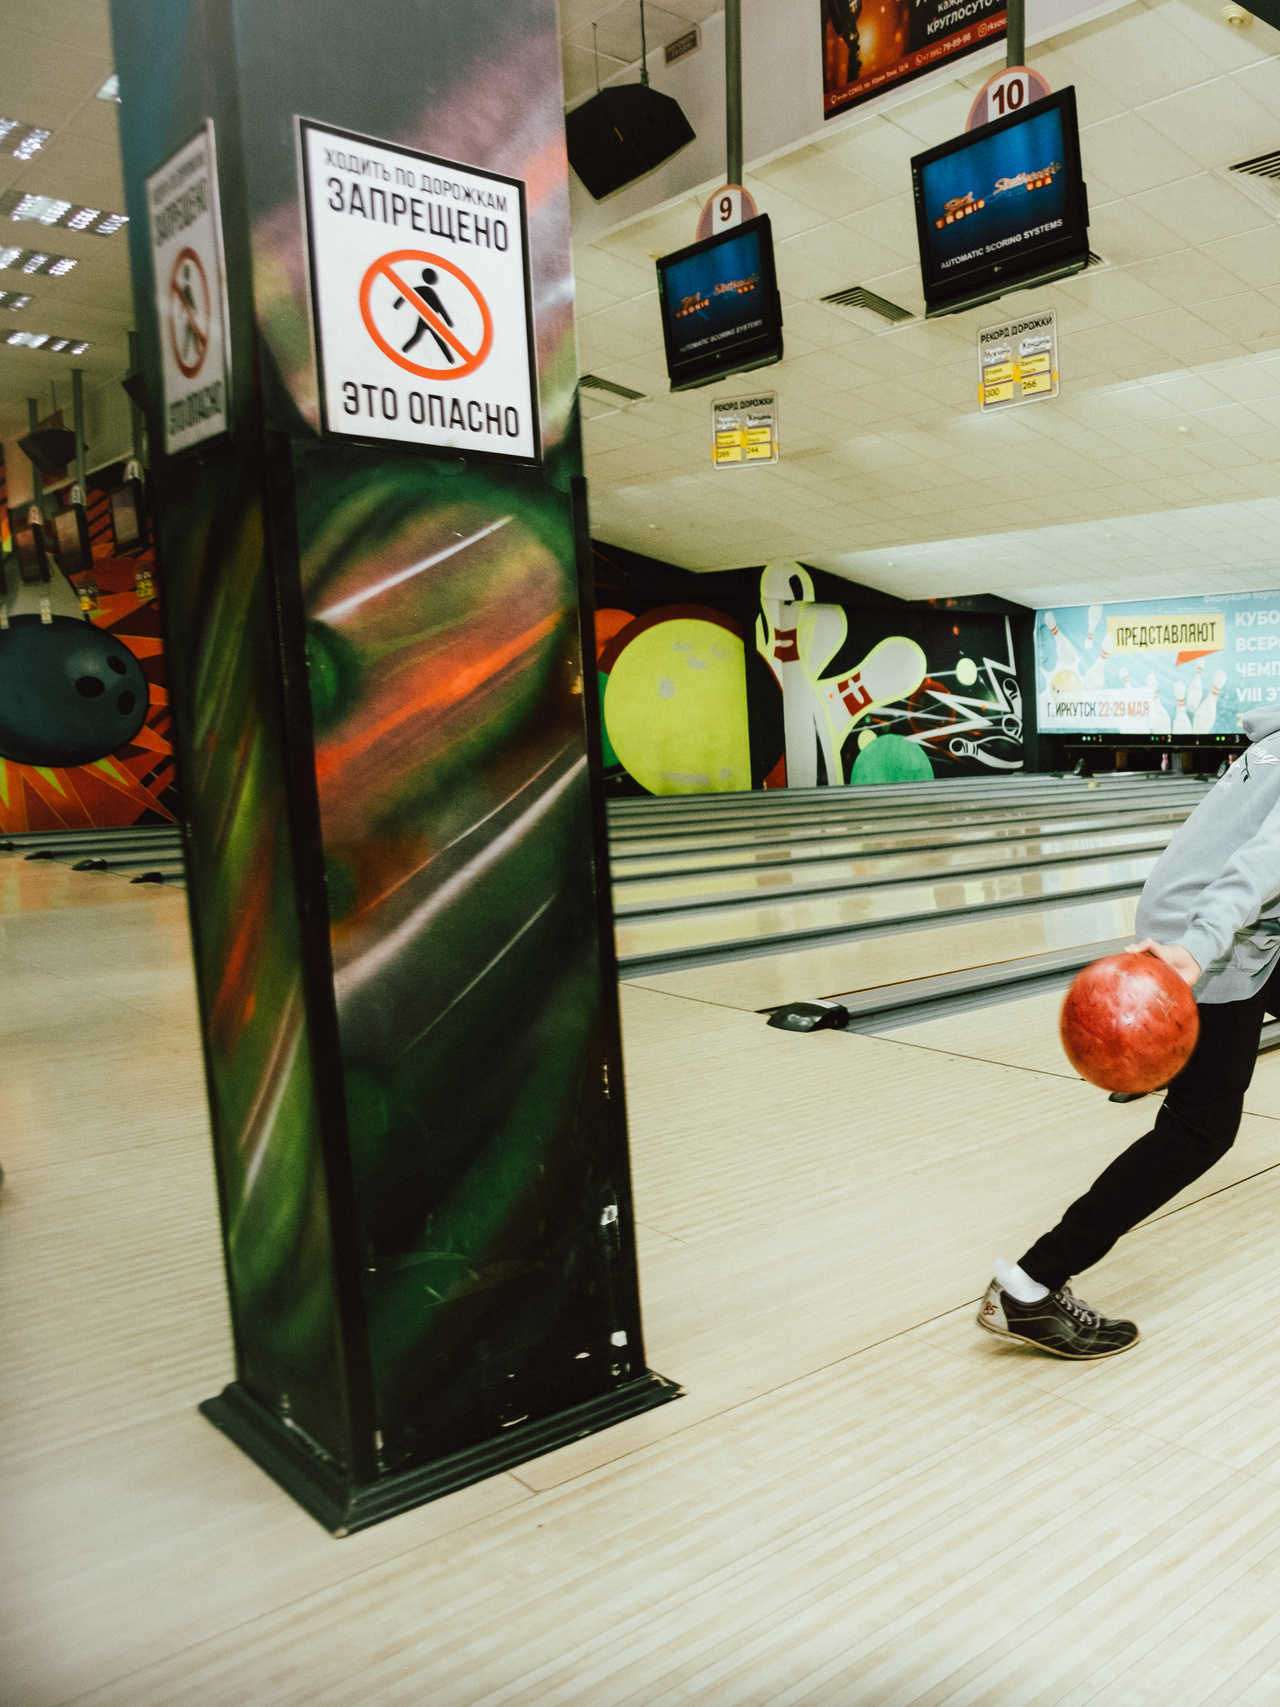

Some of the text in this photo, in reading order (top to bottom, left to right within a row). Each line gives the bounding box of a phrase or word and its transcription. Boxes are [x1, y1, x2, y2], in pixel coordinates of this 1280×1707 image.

[927, 0, 1000, 34] КРУГЛОСУТО
[992, 78, 1024, 115] 10
[324, 147, 508, 213] ХОДИТЬ ПО ДОРОЖКАМ
[327, 177, 509, 252] ЗАПРЕЩЕНО
[719, 197, 732, 222] 9
[941, 219, 1063, 269] AUTOMATIC SCORING SYSTEMS
[981, 316, 1052, 343] РЕКОРД ДОРОЖКИ
[343, 381, 520, 438] ЭТО ОПАСНО
[1116, 622, 1216, 648] ПРЕДСТАВЛЯЮТ
[1056, 701, 1097, 717] ИРКУТСК
[1099, 701, 1126, 717] 22-29
[1128, 701, 1149, 717] МАЯ
[1237, 688, 1262, 702] VIII
